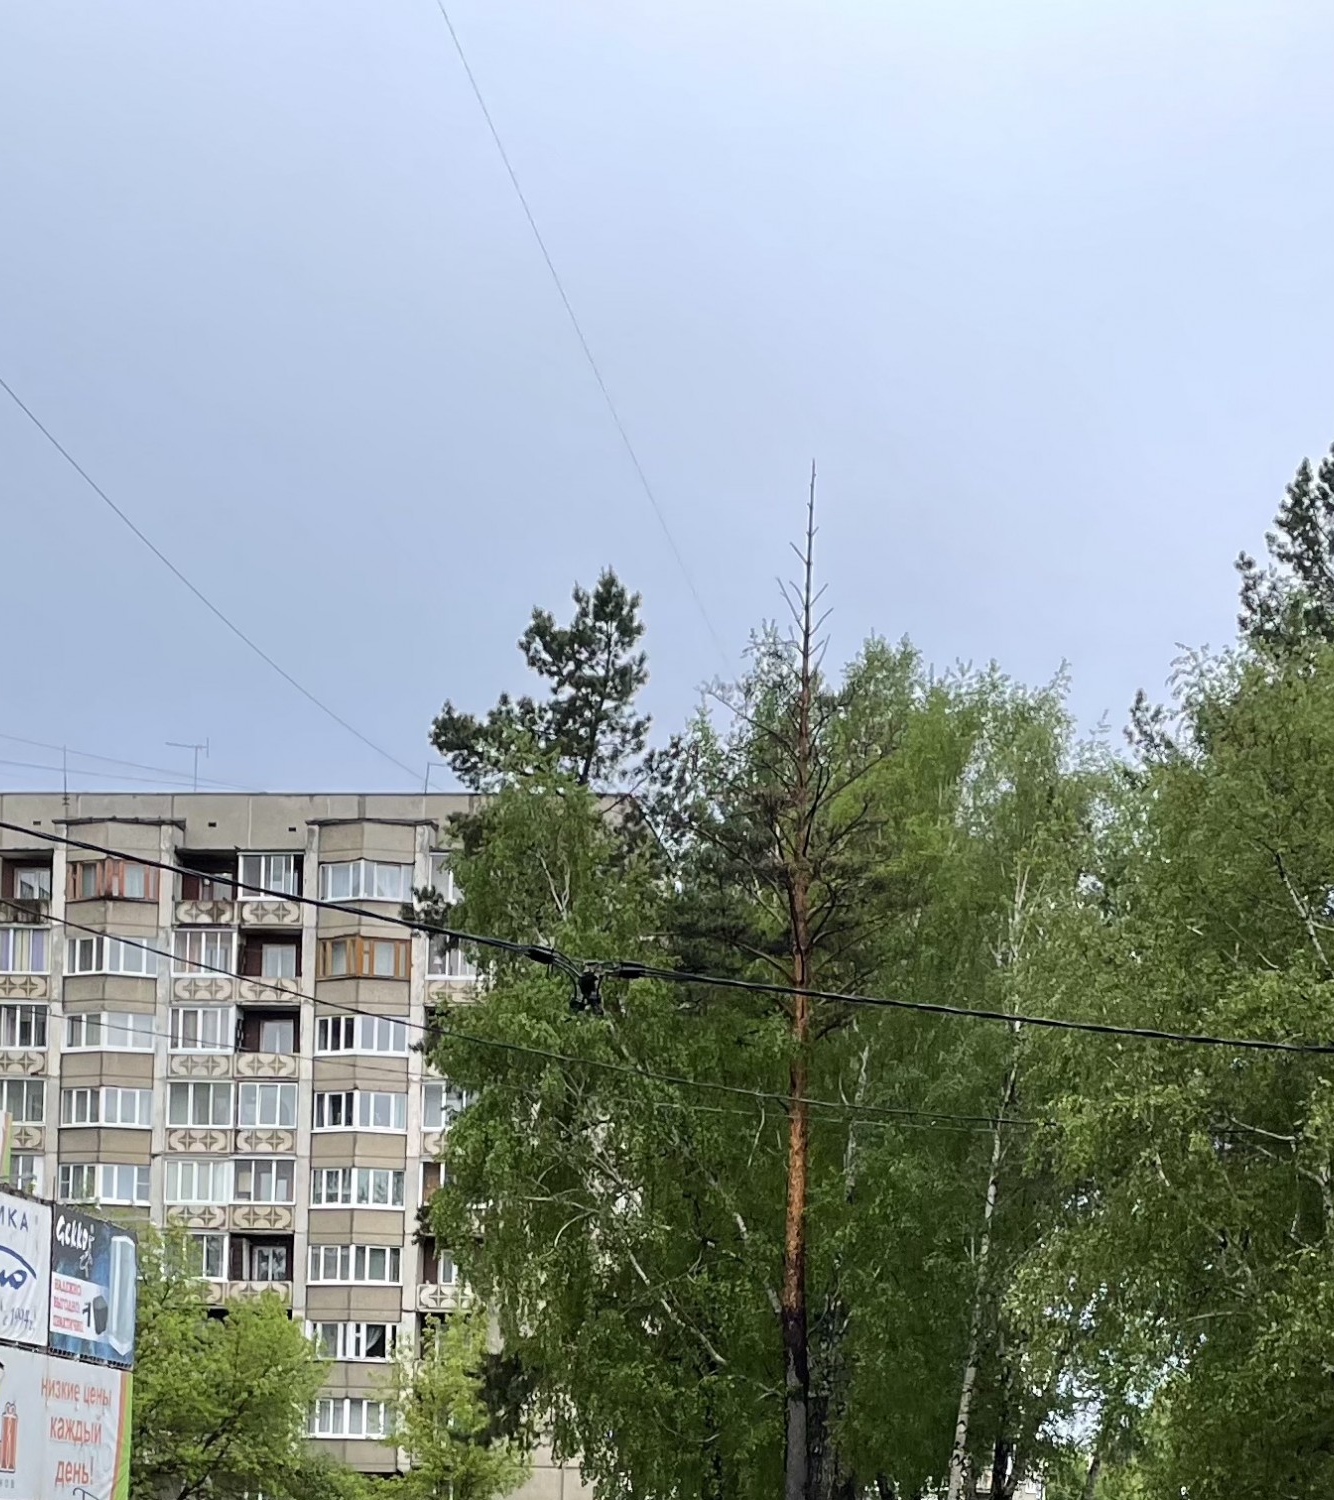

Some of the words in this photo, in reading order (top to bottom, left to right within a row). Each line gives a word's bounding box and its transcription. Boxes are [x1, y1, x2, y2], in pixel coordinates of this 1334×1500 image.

[41, 1377, 80, 1401] низкие
[83, 1384, 112, 1407] цены
[50, 1414, 102, 1446] каждый
[55, 1456, 94, 1488] день!
